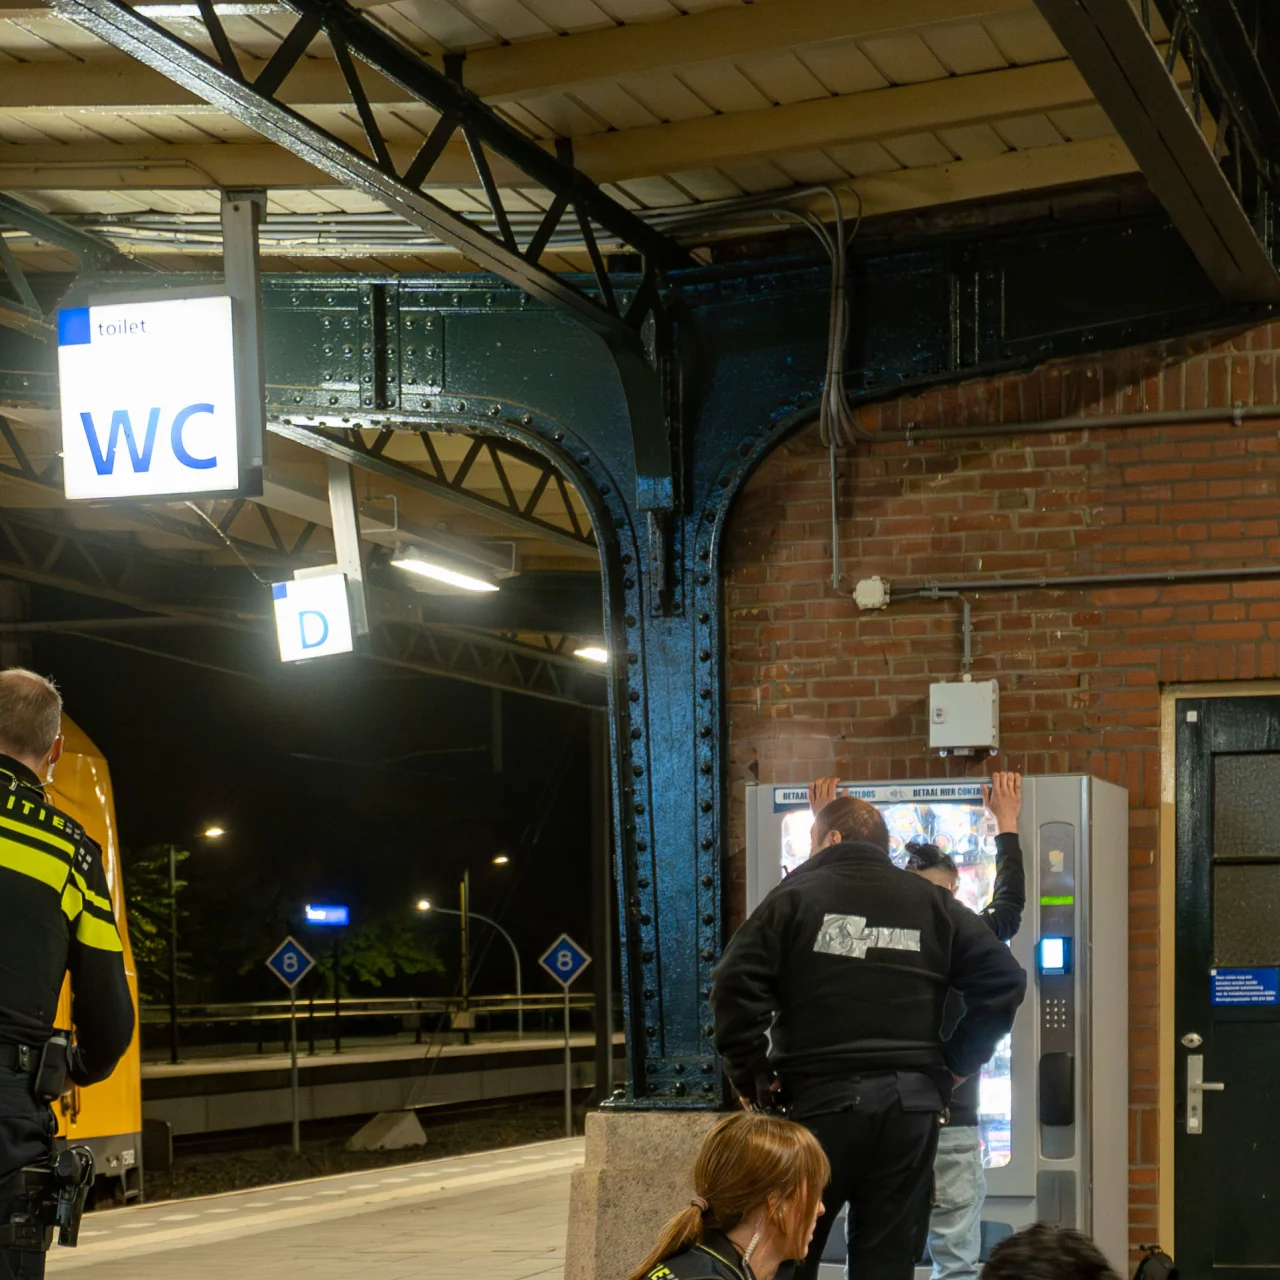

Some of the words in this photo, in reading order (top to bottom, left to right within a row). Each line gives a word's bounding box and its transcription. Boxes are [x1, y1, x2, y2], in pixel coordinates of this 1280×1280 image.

[98, 318, 147, 337] toilet
[79, 402, 218, 476] WC
[298, 610, 329, 649] D
[782, 791, 808, 800] BETAAL
[912, 788, 938, 798] BETAAL
[940, 787, 956, 797] HIER
[283, 952, 298, 973] 8
[557, 950, 573, 971] 8
